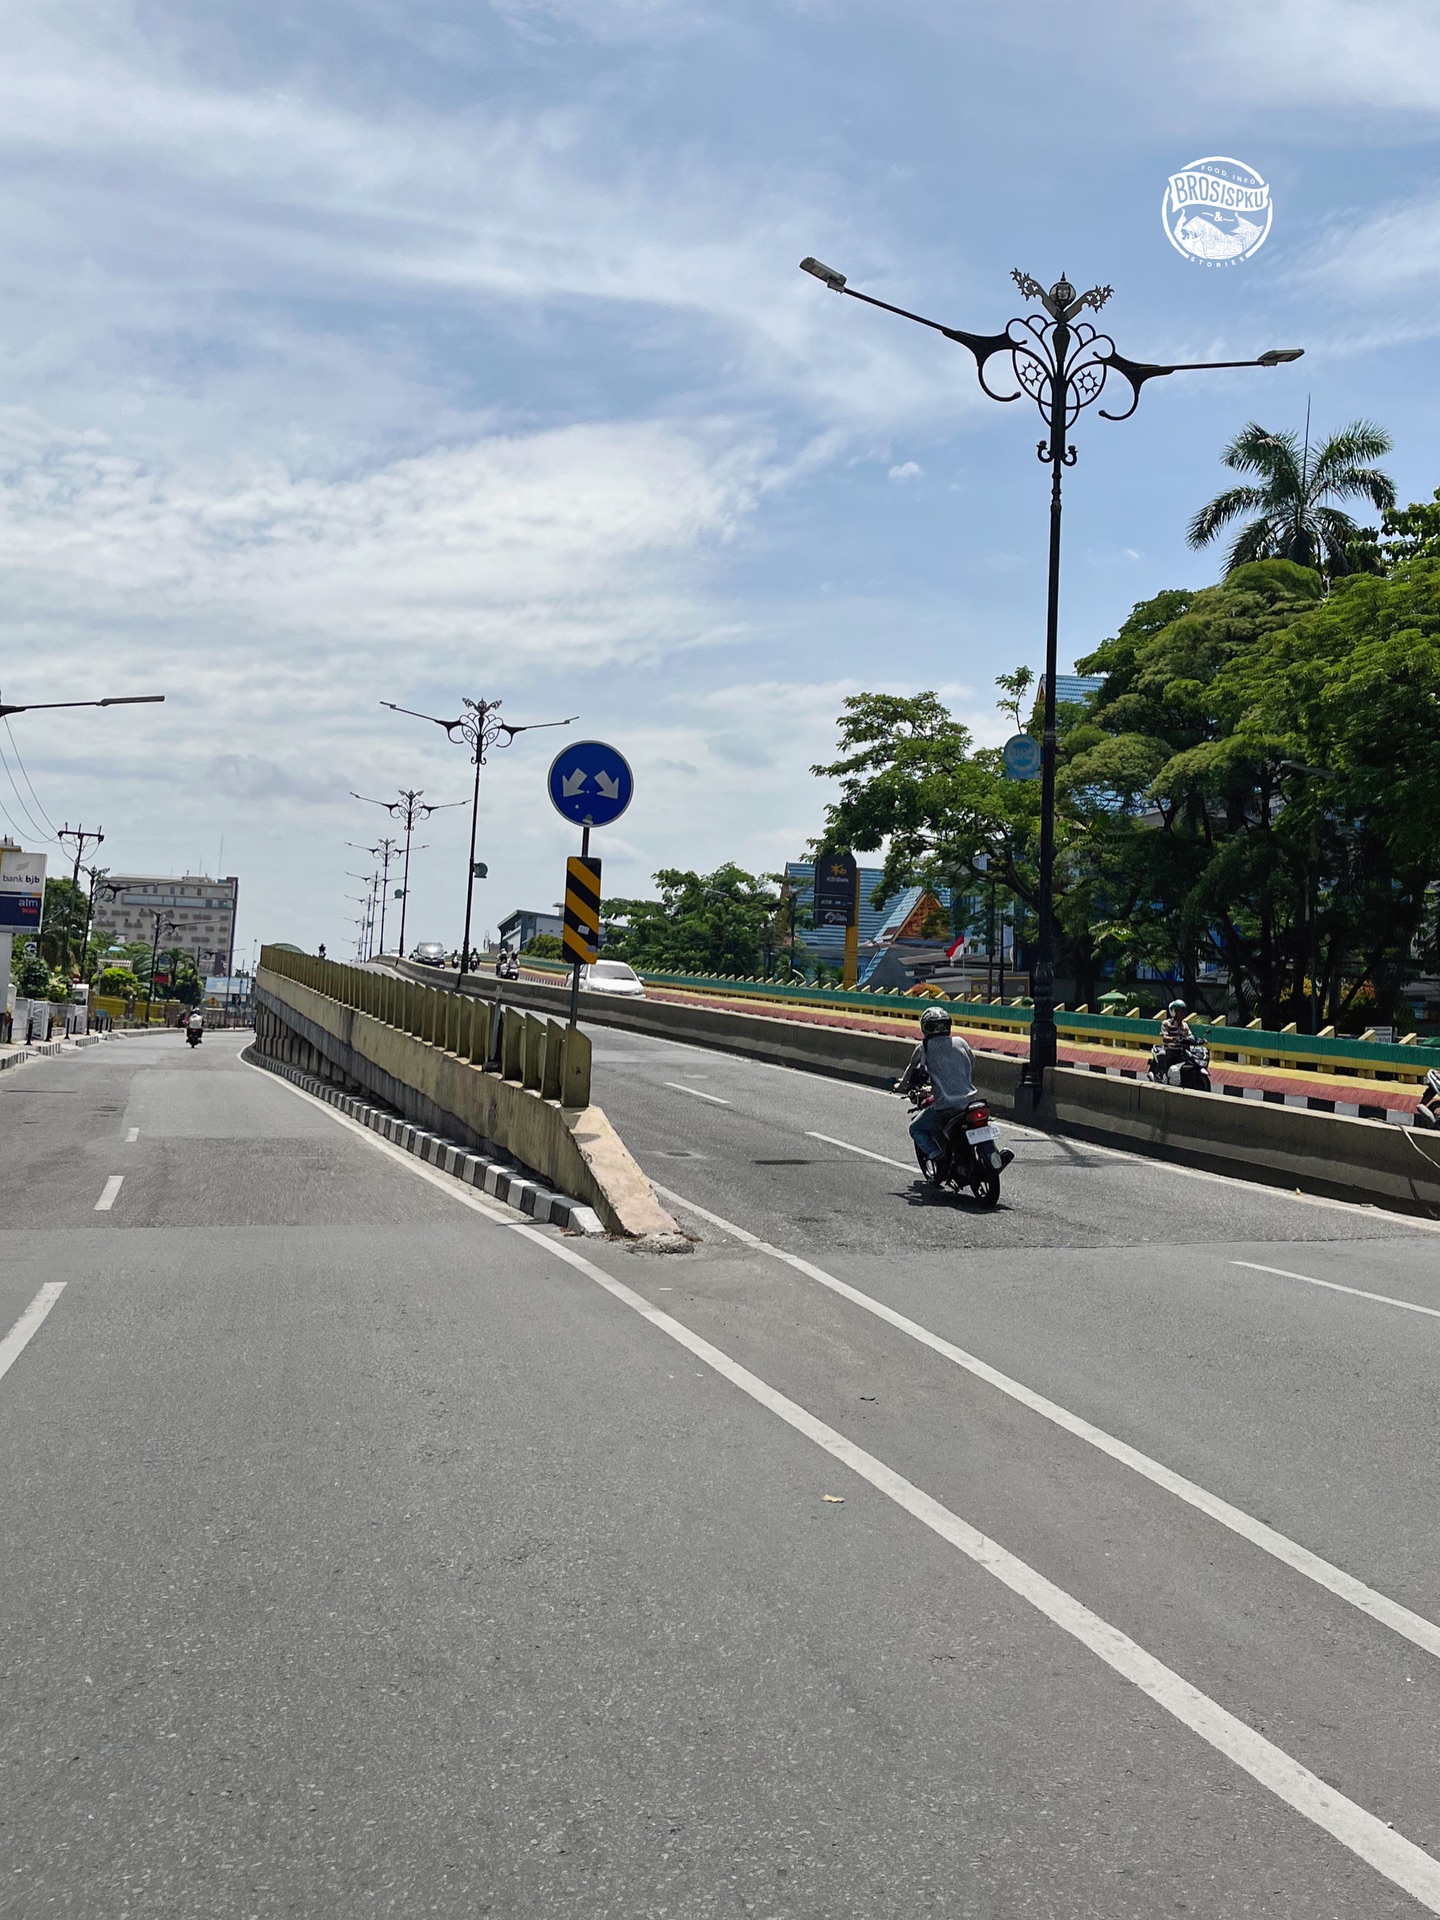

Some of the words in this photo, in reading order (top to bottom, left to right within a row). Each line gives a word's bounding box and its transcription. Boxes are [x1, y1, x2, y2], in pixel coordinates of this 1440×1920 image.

[3, 875, 23, 883] bank
[25, 875, 40, 885] bjb
[18, 898, 38, 907] atm
